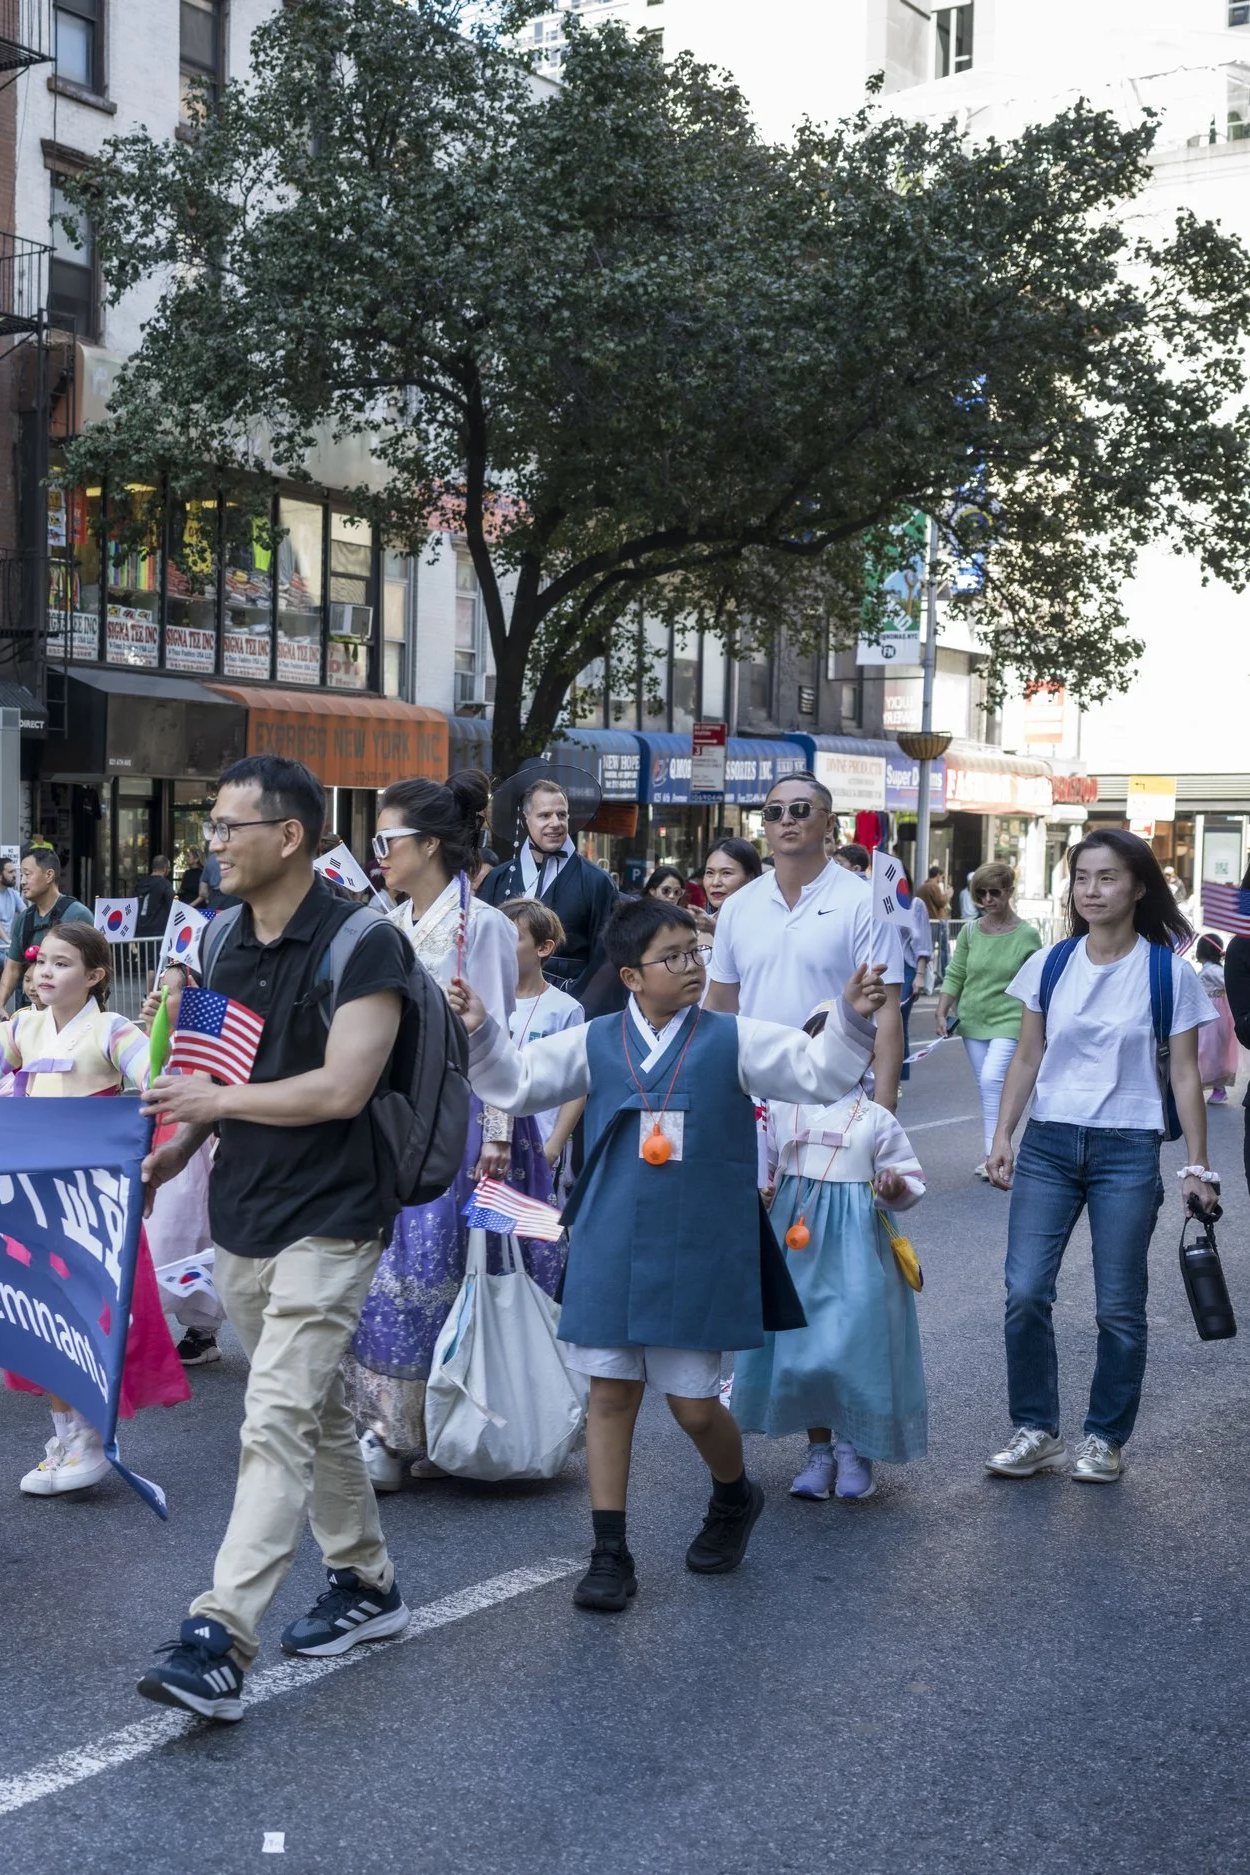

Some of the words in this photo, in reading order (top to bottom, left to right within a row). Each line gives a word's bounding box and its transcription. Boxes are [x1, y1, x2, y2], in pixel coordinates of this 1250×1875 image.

[130, 624, 144, 644] TEE
[144, 626, 158, 645] INC
[189, 630, 201, 649] TEE
[202, 632, 214, 651] INC
[244, 637, 257, 655] TEE
[257, 639, 269, 656] INC
[255, 721, 327, 758] EXPRESS
[333, 727, 365, 759] NEW
[372, 730, 410, 761] YORK
[603, 754, 619, 770] NEW
[620, 755, 641, 770] HOPE
[887, 764, 912, 789] Super
